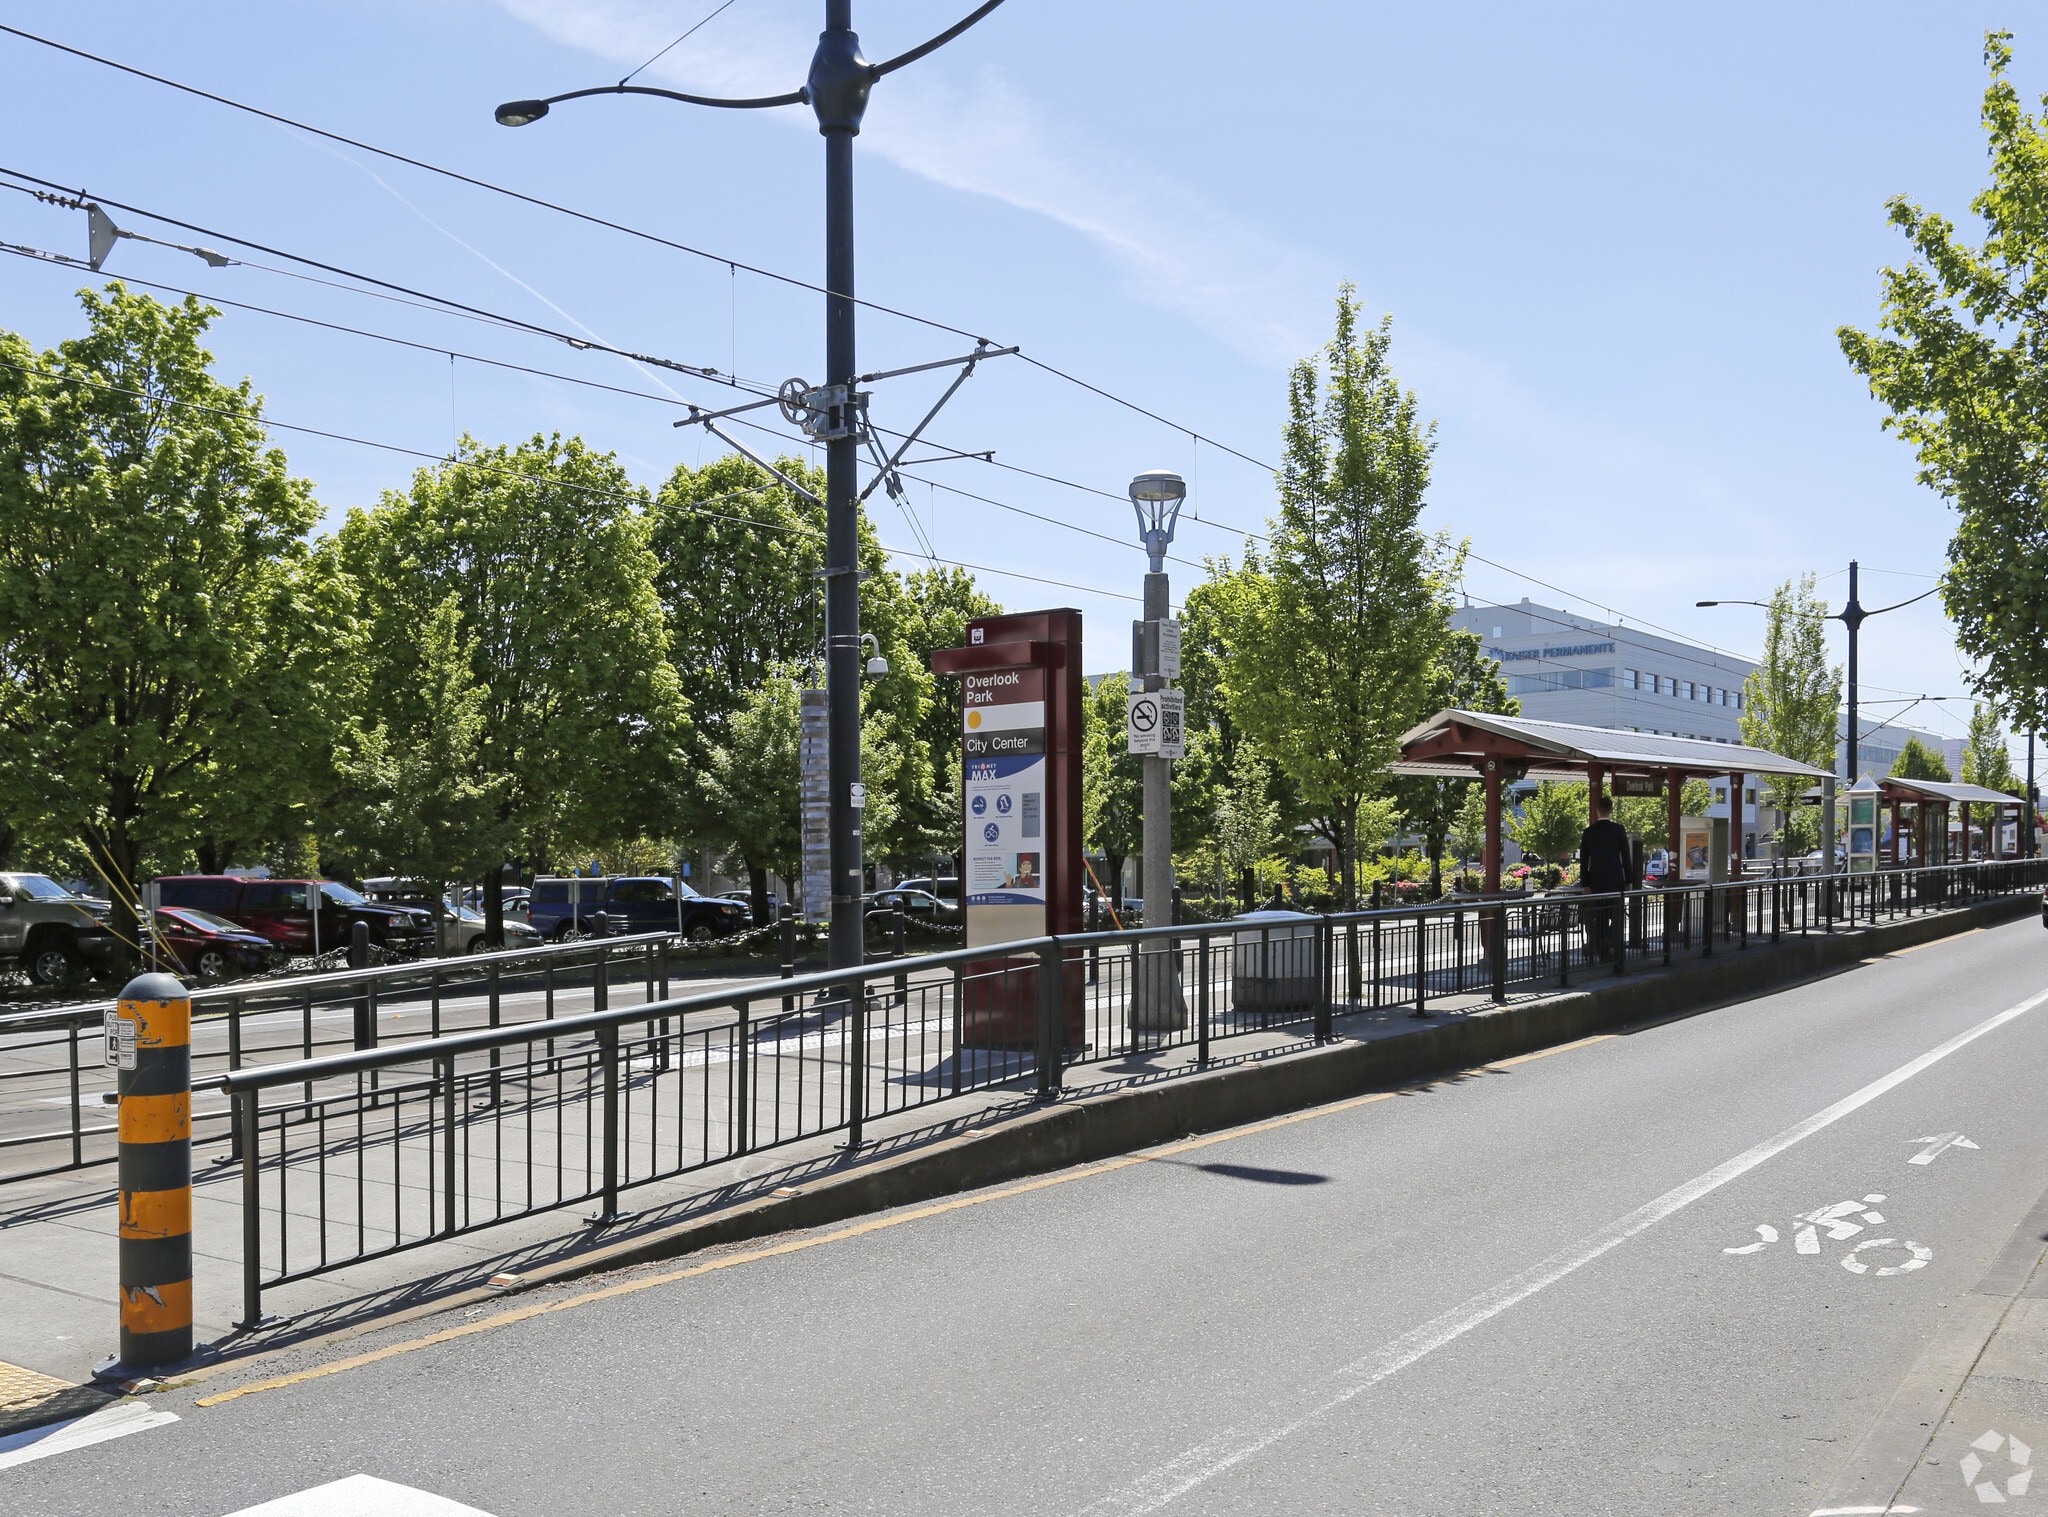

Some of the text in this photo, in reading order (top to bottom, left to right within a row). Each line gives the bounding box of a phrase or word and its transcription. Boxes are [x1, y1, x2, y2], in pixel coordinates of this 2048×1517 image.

[1505, 643, 1615, 661] KAISER PERMANENTE
[966, 672, 1019, 688] Overlook
[966, 690, 993, 704] Park
[1160, 695, 1183, 704] Prohibited
[1161, 703, 1181, 711] activities
[967, 737, 1028, 753] City Center
[971, 769, 997, 781] MAX
